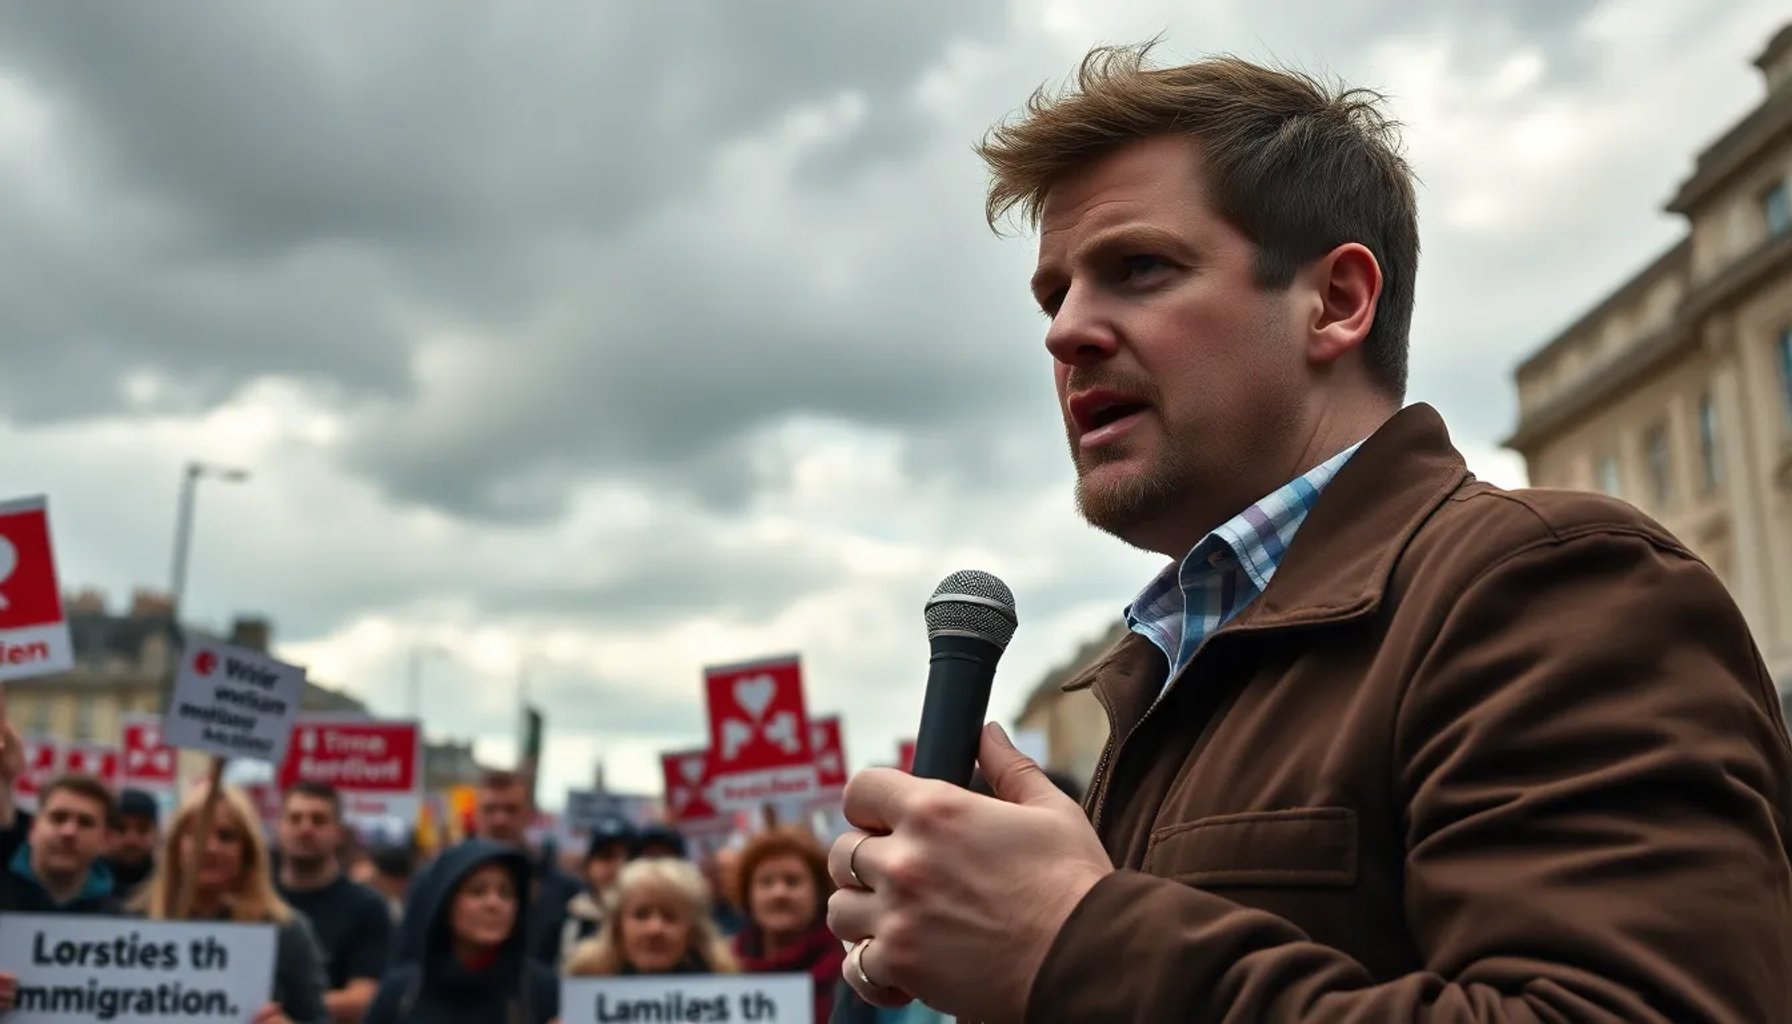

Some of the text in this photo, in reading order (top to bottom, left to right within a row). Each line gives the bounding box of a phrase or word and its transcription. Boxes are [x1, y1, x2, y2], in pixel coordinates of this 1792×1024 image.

[33, 930, 229, 970] Lorsties th
[739, 990, 777, 1021] th
